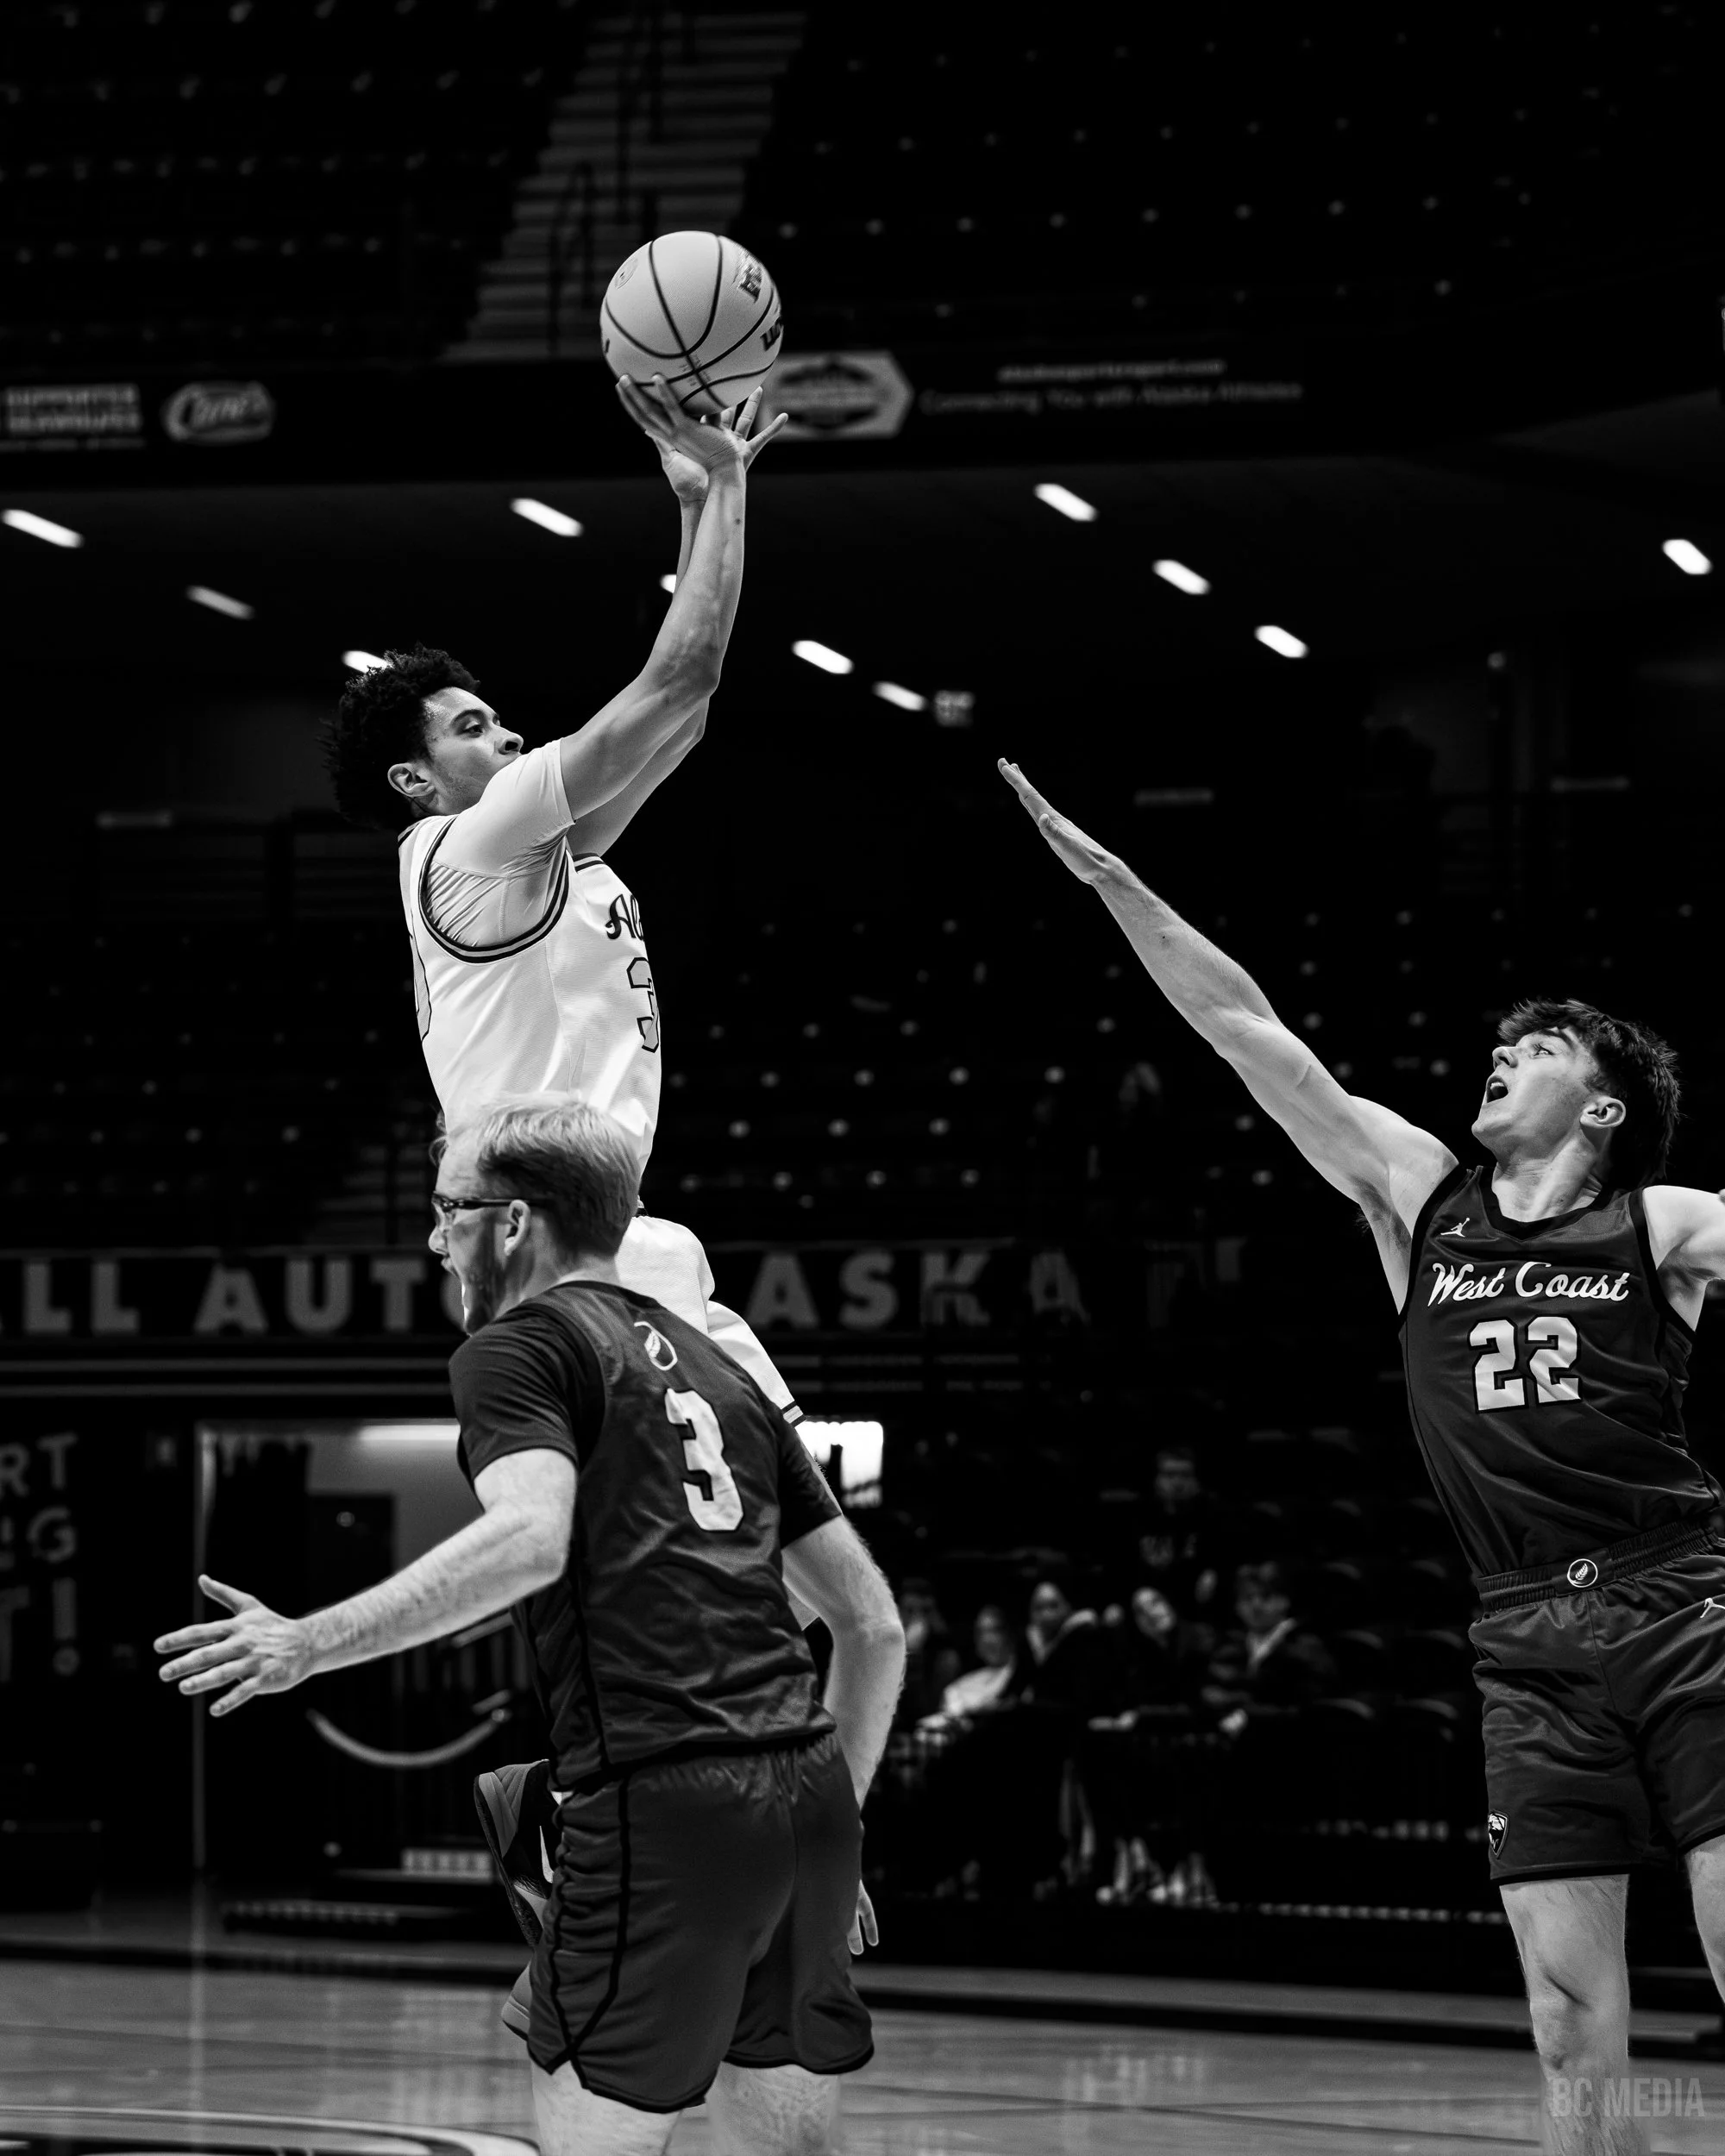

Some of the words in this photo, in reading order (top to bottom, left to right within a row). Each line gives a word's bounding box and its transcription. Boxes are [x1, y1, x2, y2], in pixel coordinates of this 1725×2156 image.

[0, 1257, 142, 1336] LL
[743, 1248, 1092, 1331] ASKA
[1427, 1263, 1507, 1307] West
[1515, 1261, 1631, 1302] Coast
[1468, 1314, 1582, 1413] 22
[664, 1387, 744, 1532] 3
